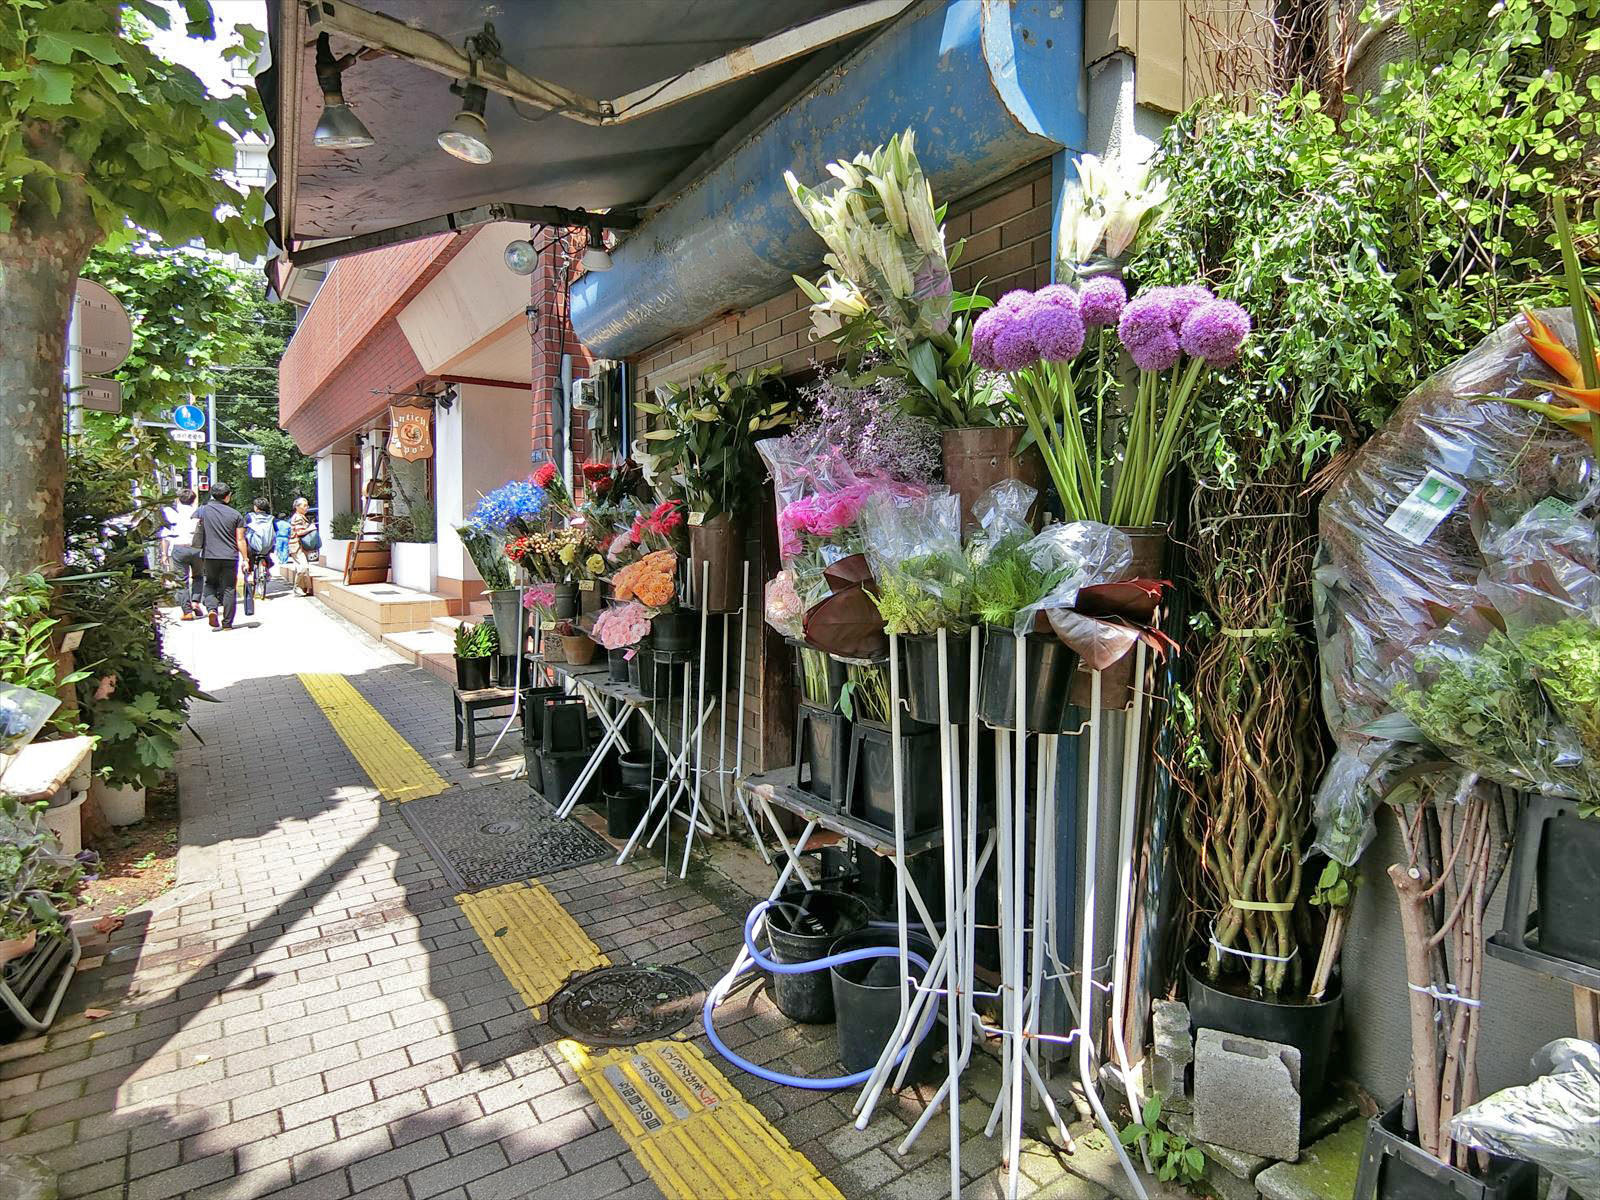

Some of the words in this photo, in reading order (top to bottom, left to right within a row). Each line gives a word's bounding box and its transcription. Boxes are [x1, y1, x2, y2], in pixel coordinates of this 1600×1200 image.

[618, 1081, 662, 1130] 目の不自由な
